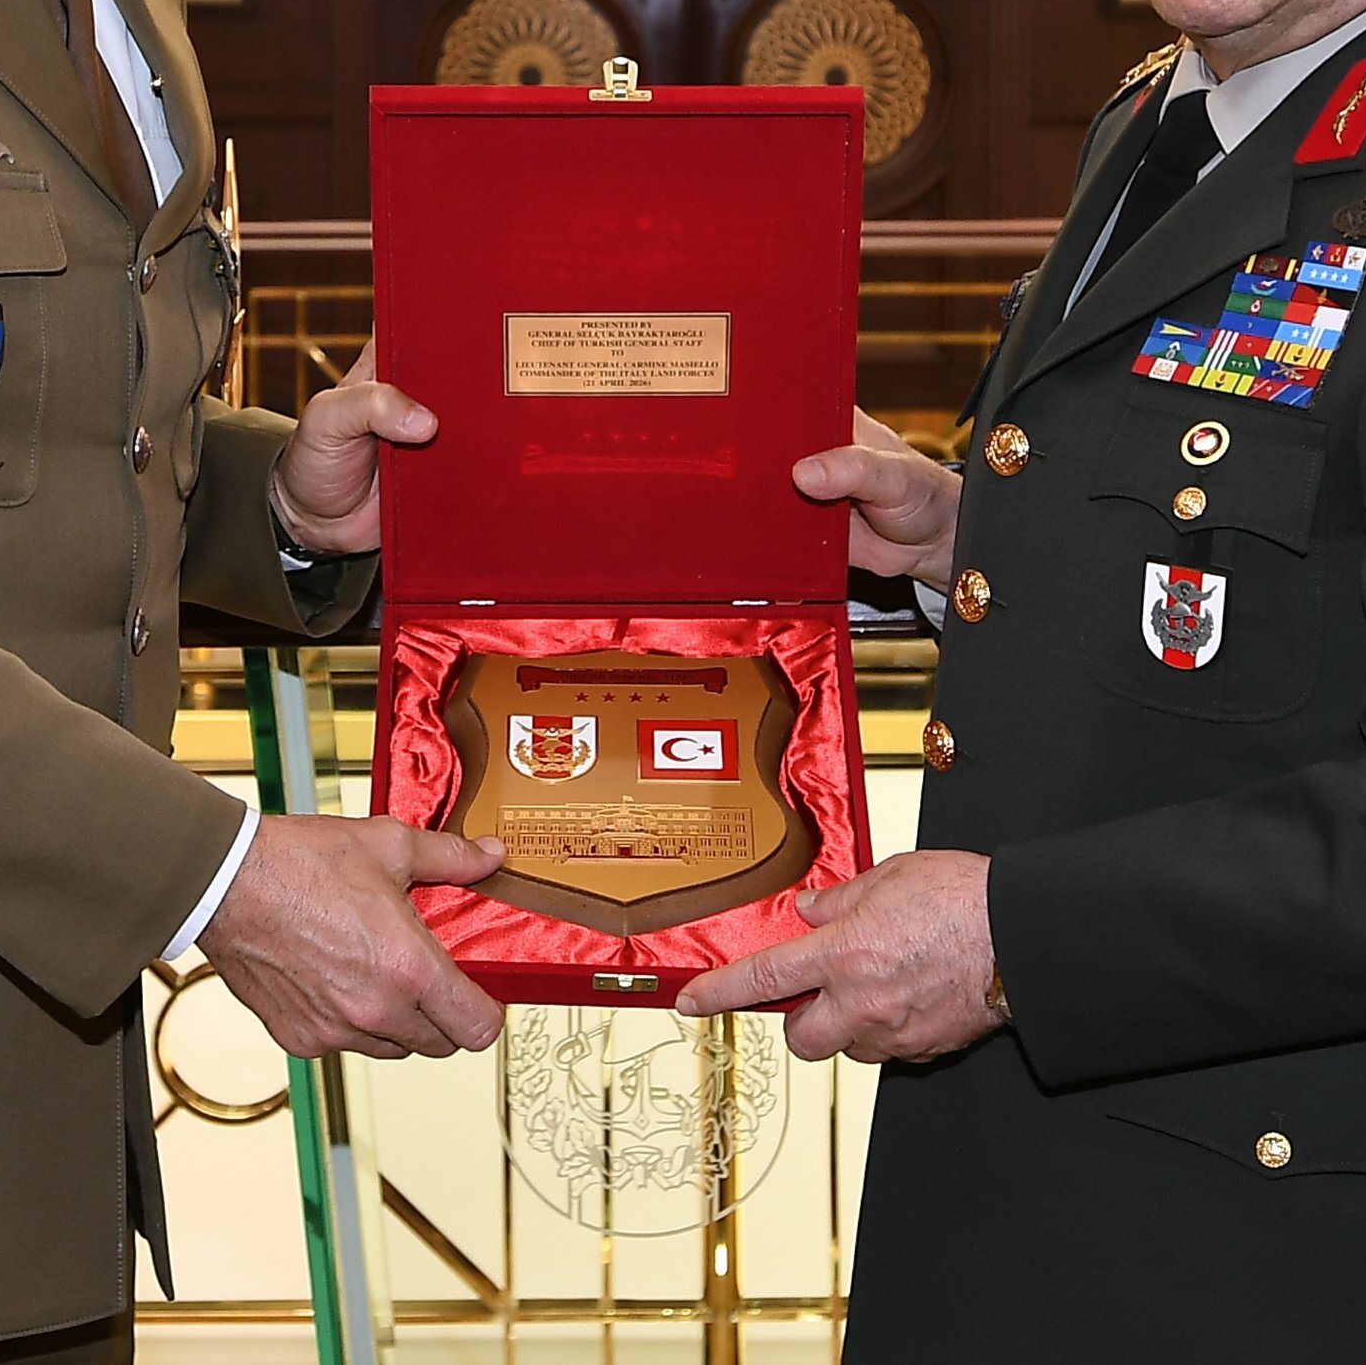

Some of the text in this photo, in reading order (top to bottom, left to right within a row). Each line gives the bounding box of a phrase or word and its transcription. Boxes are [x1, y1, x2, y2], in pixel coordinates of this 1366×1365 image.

[581, 321, 652, 329] PRESENTED BY
[515, 361, 574, 369] LIEUTENANT
[577, 361, 622, 369] GENERAL
[519, 370, 581, 378] COMMANDER
